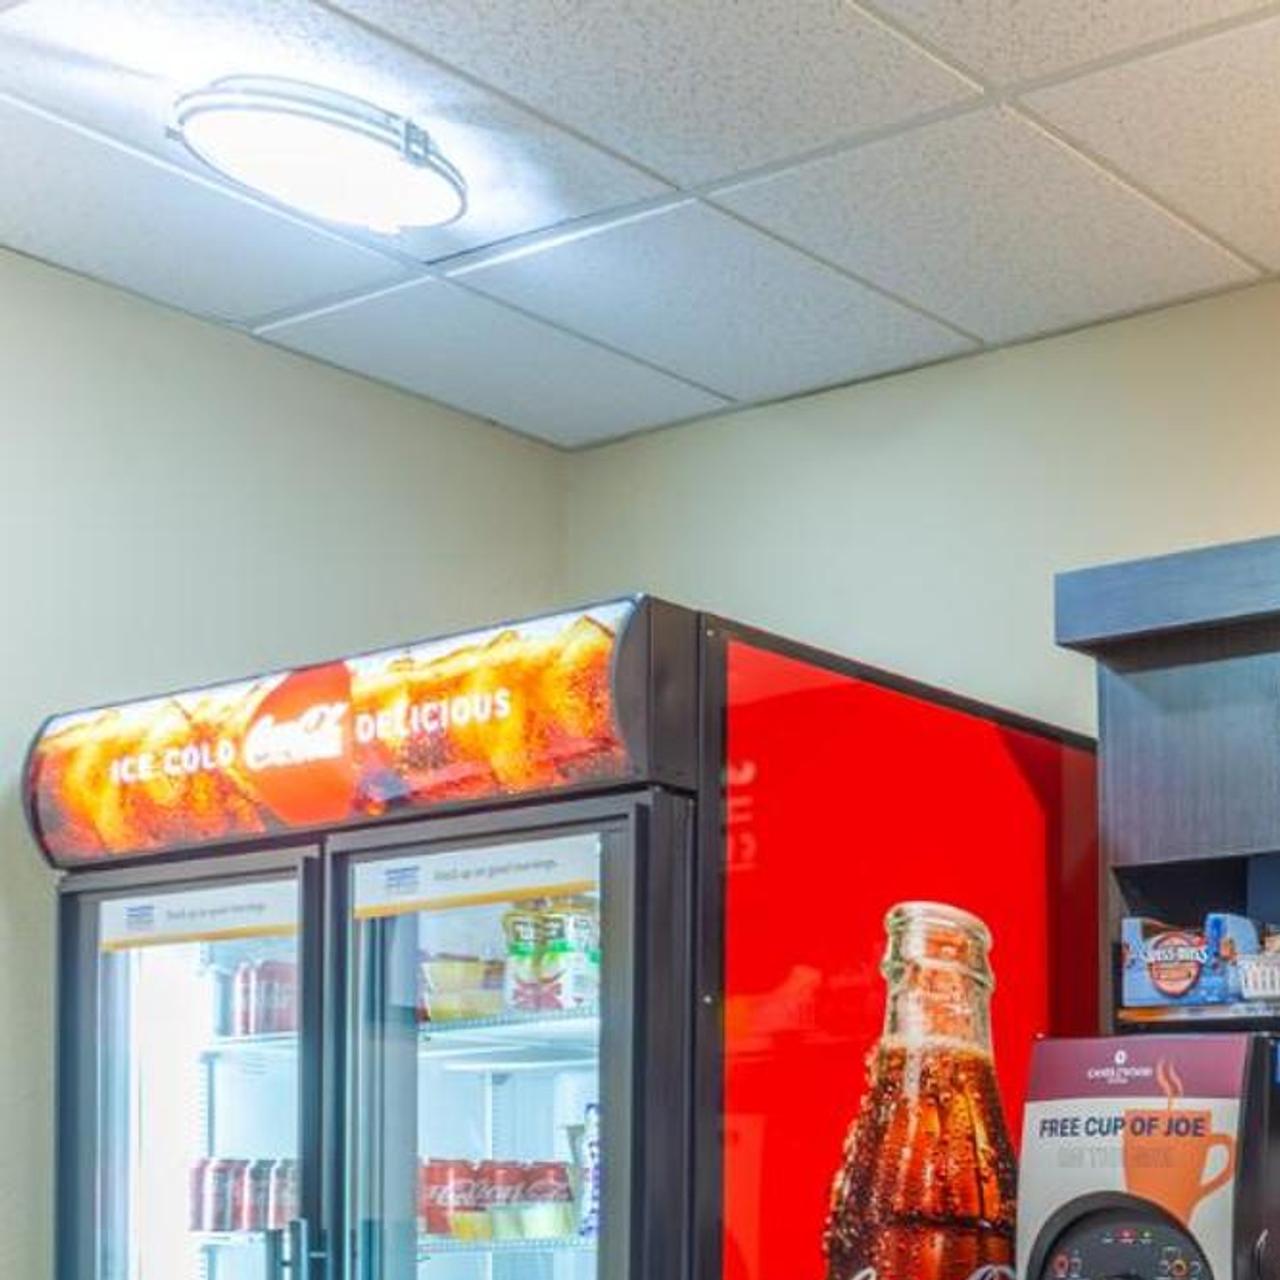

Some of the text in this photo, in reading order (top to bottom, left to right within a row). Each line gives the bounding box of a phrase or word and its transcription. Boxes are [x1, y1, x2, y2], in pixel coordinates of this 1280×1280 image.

[355, 687, 512, 744] DELICIOUS
[110, 741, 236, 785] ICE COLD
[1039, 1116, 1206, 1138] FREE CUP OF JOE
